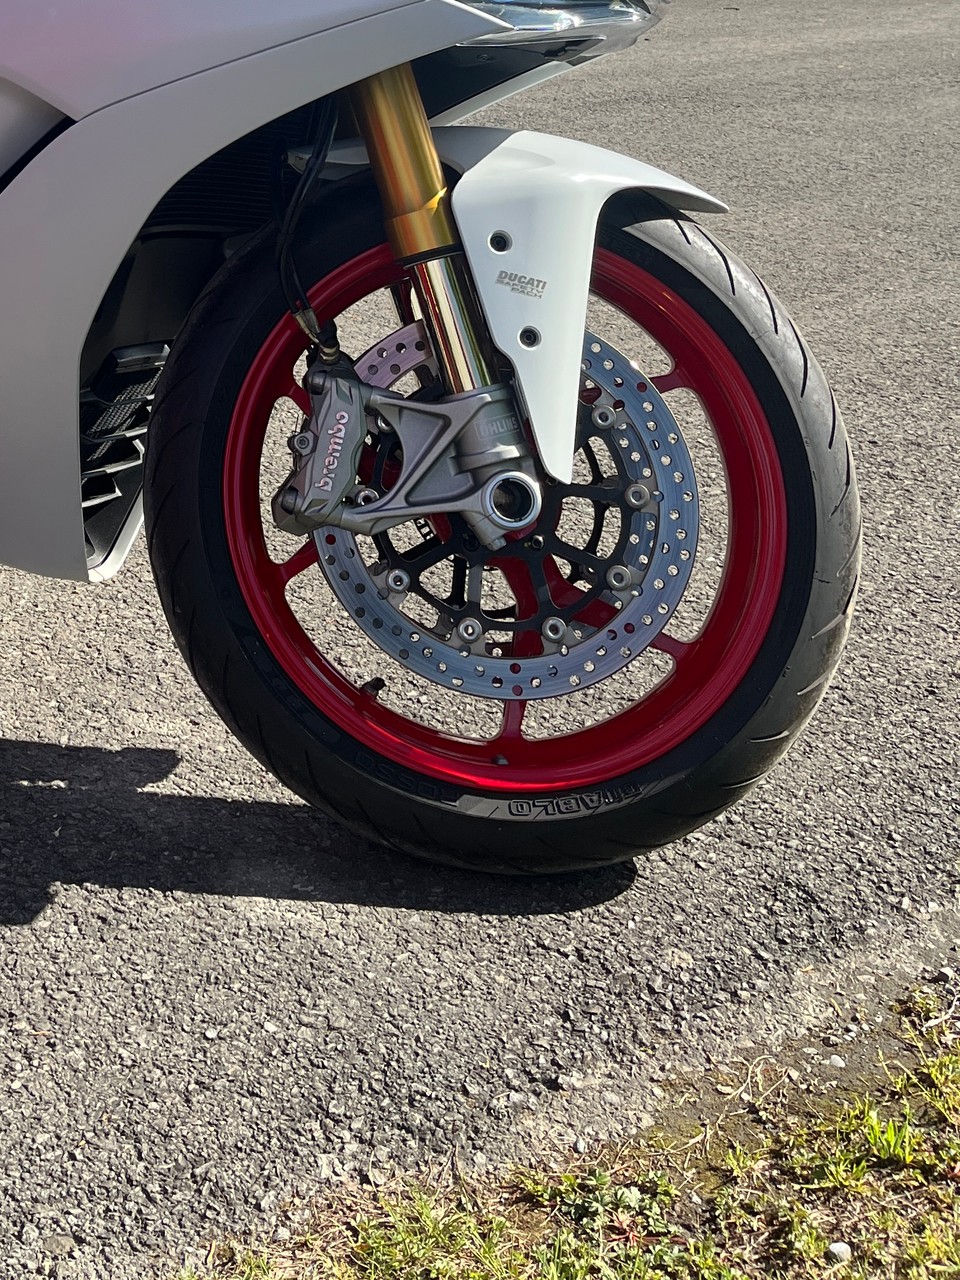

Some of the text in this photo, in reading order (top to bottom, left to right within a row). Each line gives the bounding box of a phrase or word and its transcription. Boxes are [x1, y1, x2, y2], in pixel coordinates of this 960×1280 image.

[497, 270, 548, 290] DUCATI
[314, 411, 349, 492] brembo
[507, 782, 643, 817] DIABLO
